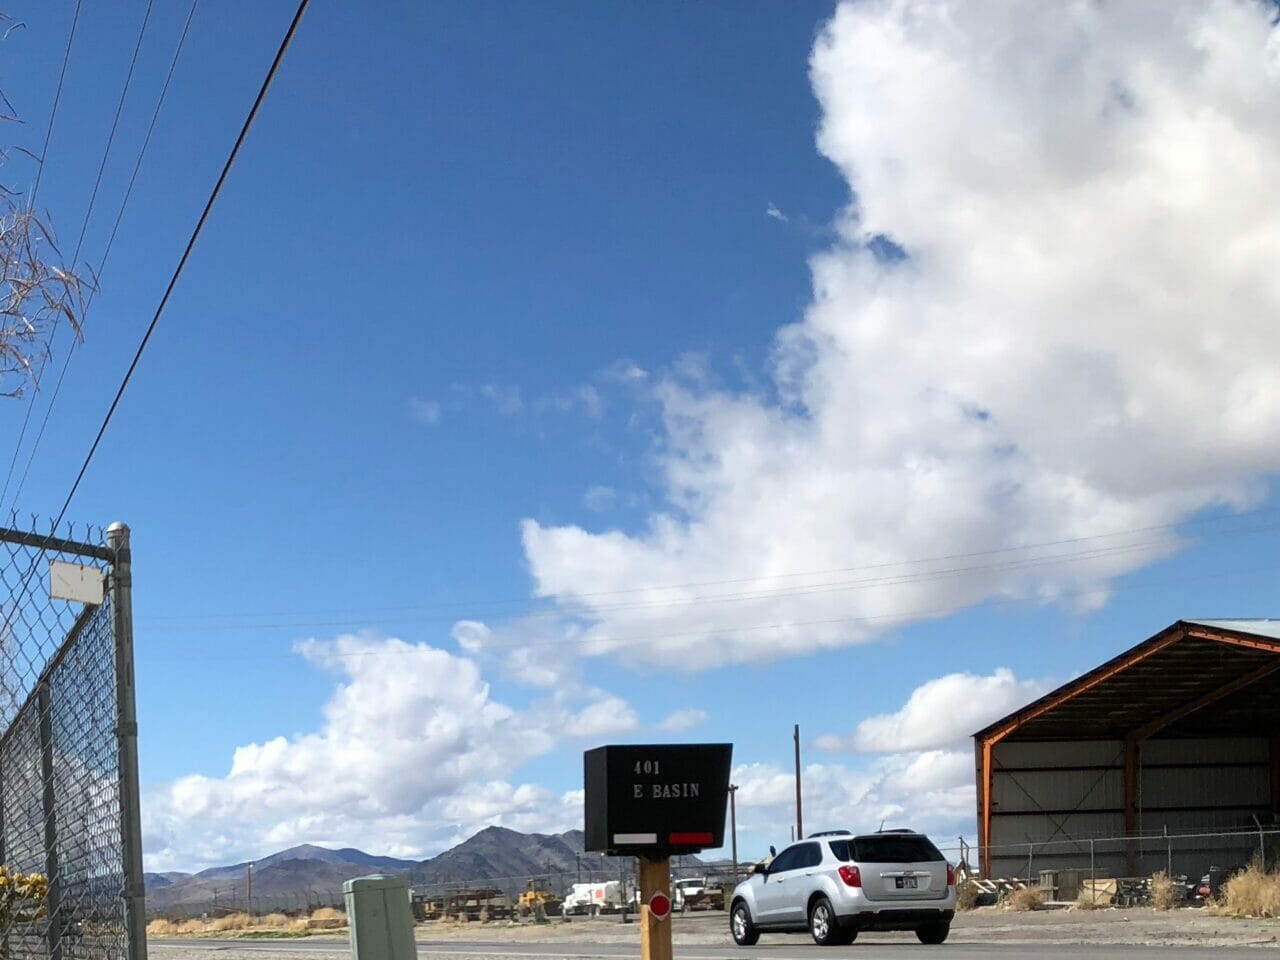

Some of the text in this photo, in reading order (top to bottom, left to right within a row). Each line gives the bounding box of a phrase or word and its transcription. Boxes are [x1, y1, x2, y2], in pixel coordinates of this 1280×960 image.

[634, 760, 660, 775] 401
[634, 783, 700, 798] E BASIN
